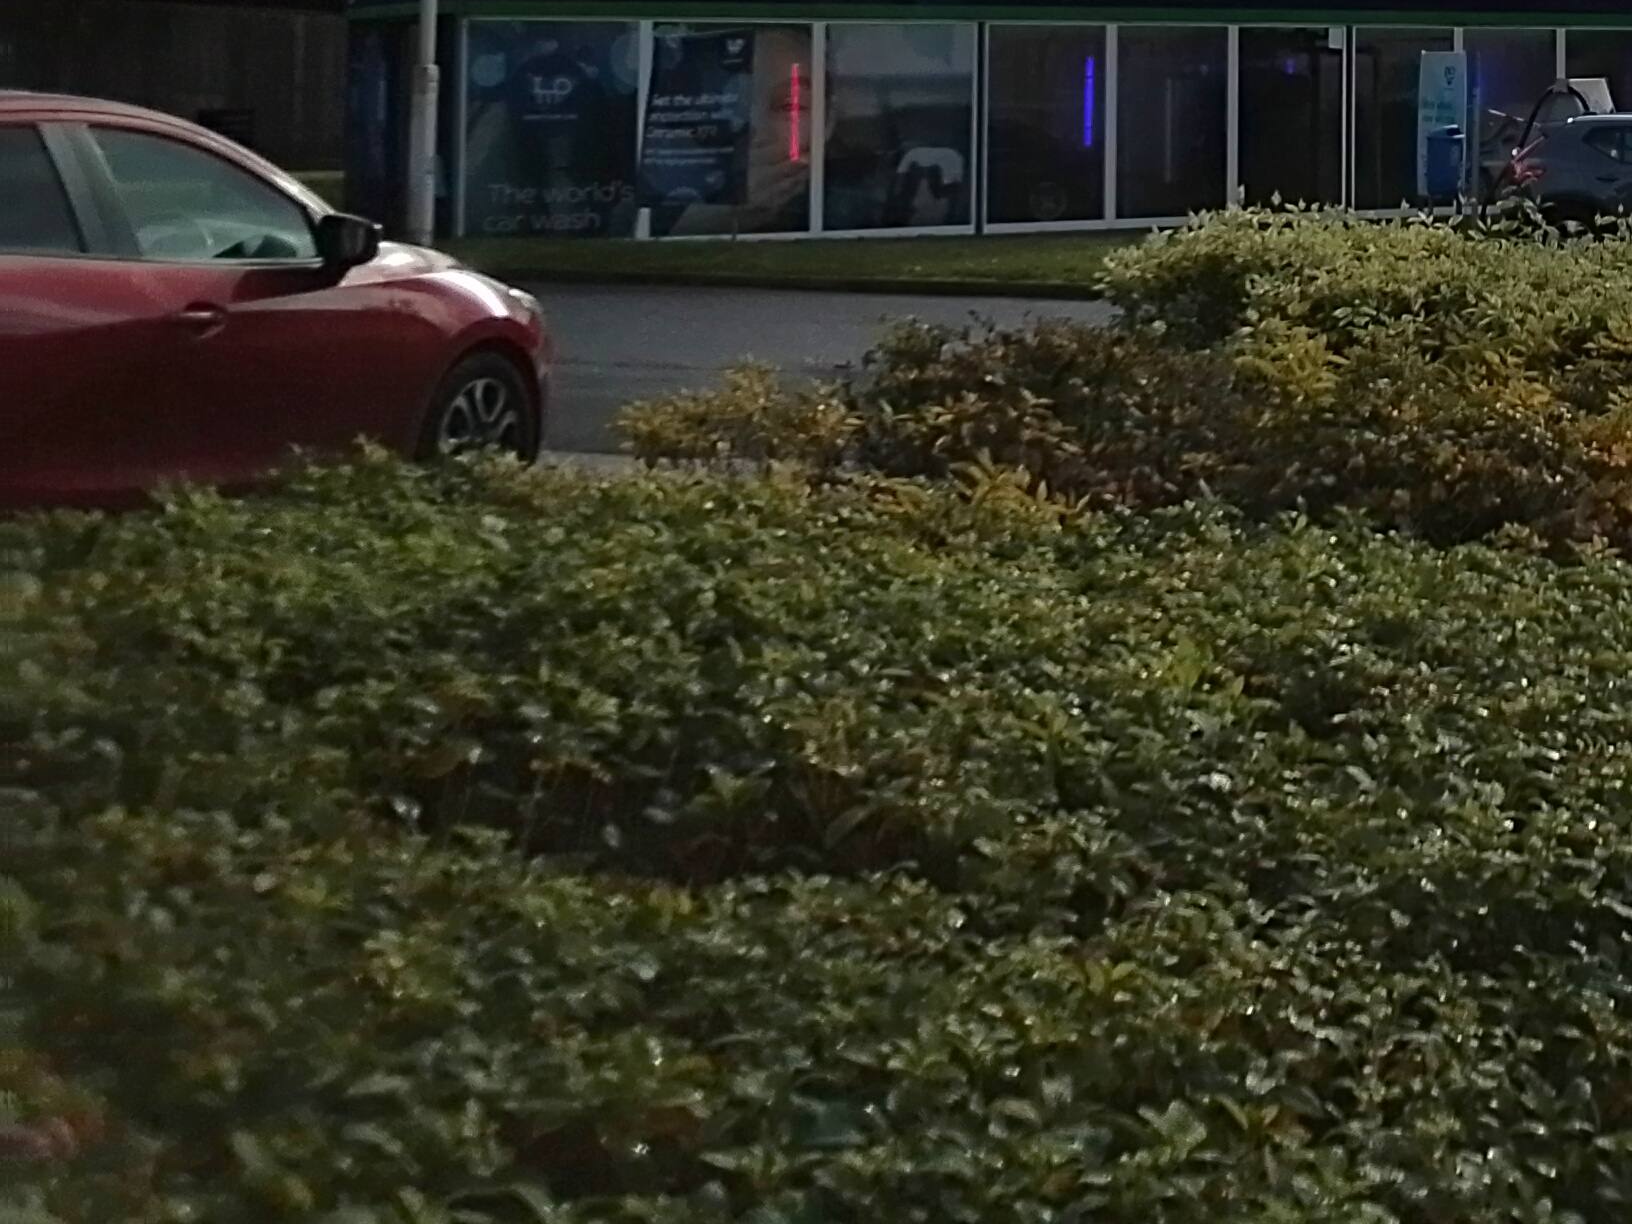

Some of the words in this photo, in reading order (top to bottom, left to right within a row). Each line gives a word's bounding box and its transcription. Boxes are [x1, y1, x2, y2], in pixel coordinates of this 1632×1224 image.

[487, 182, 538, 204] The
[482, 214, 526, 232] car
[530, 208, 603, 231] wash
